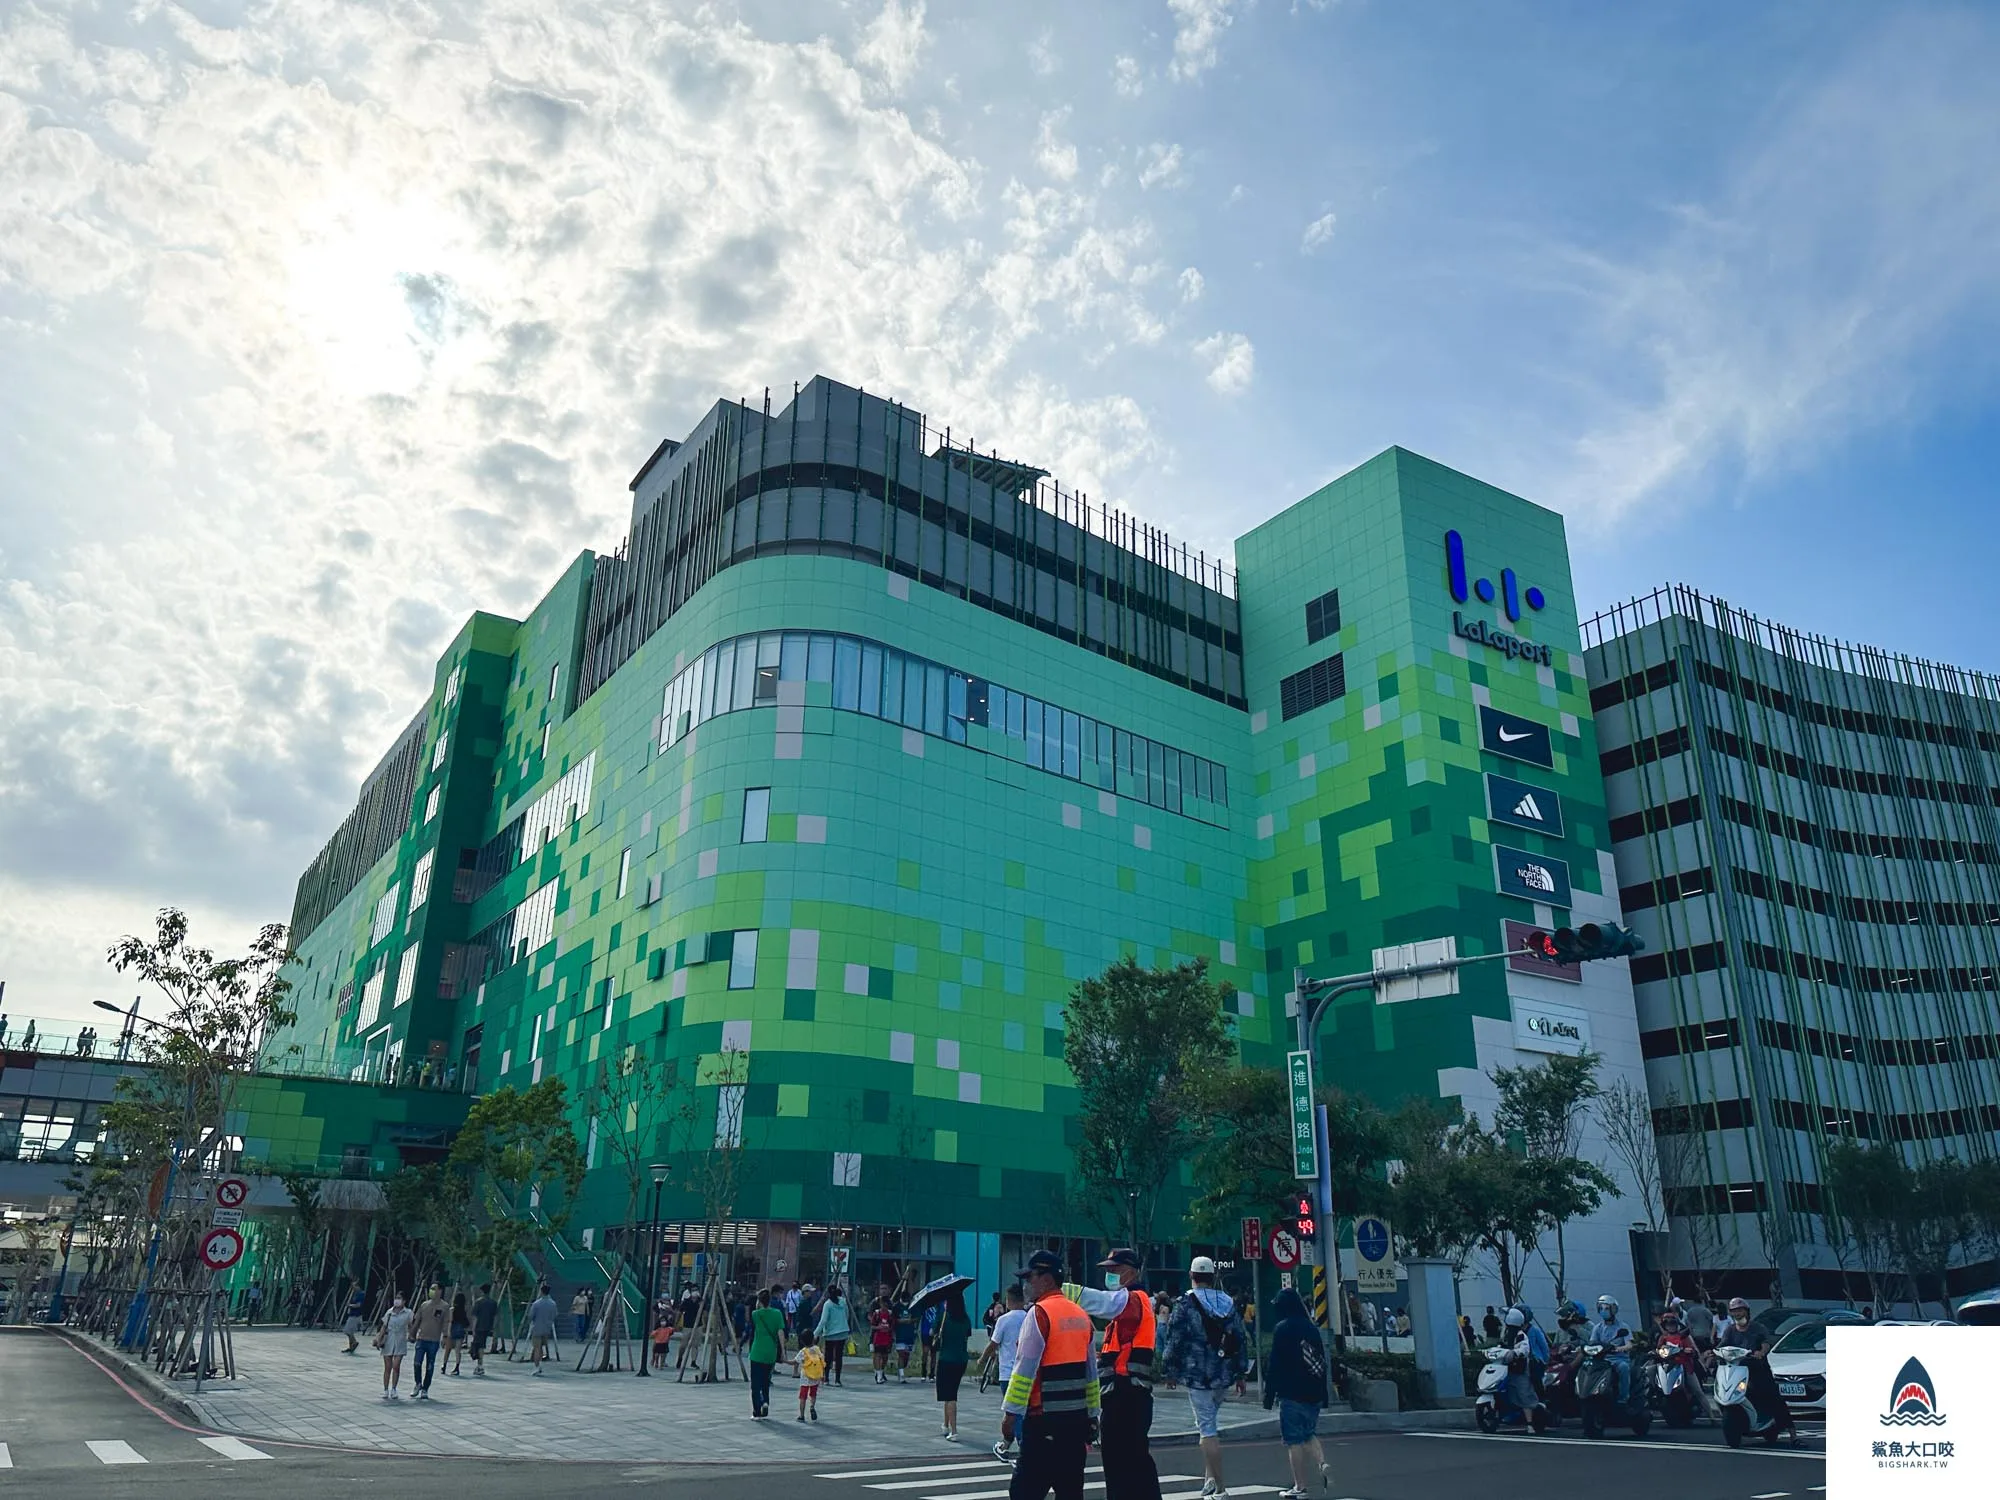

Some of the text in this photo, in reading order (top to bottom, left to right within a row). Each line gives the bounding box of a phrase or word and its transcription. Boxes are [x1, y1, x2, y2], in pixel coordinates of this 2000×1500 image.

[1453, 611, 1551, 667] LaLaport
[1517, 868, 1542, 881] NORTH
[1527, 863, 1541, 874] THE
[1525, 878, 1543, 889] FACE
[1294, 1071, 1310, 1138] 進德路
[1298, 1219, 1313, 1234] 49
[1358, 1268, 1395, 1280] 行人優先
